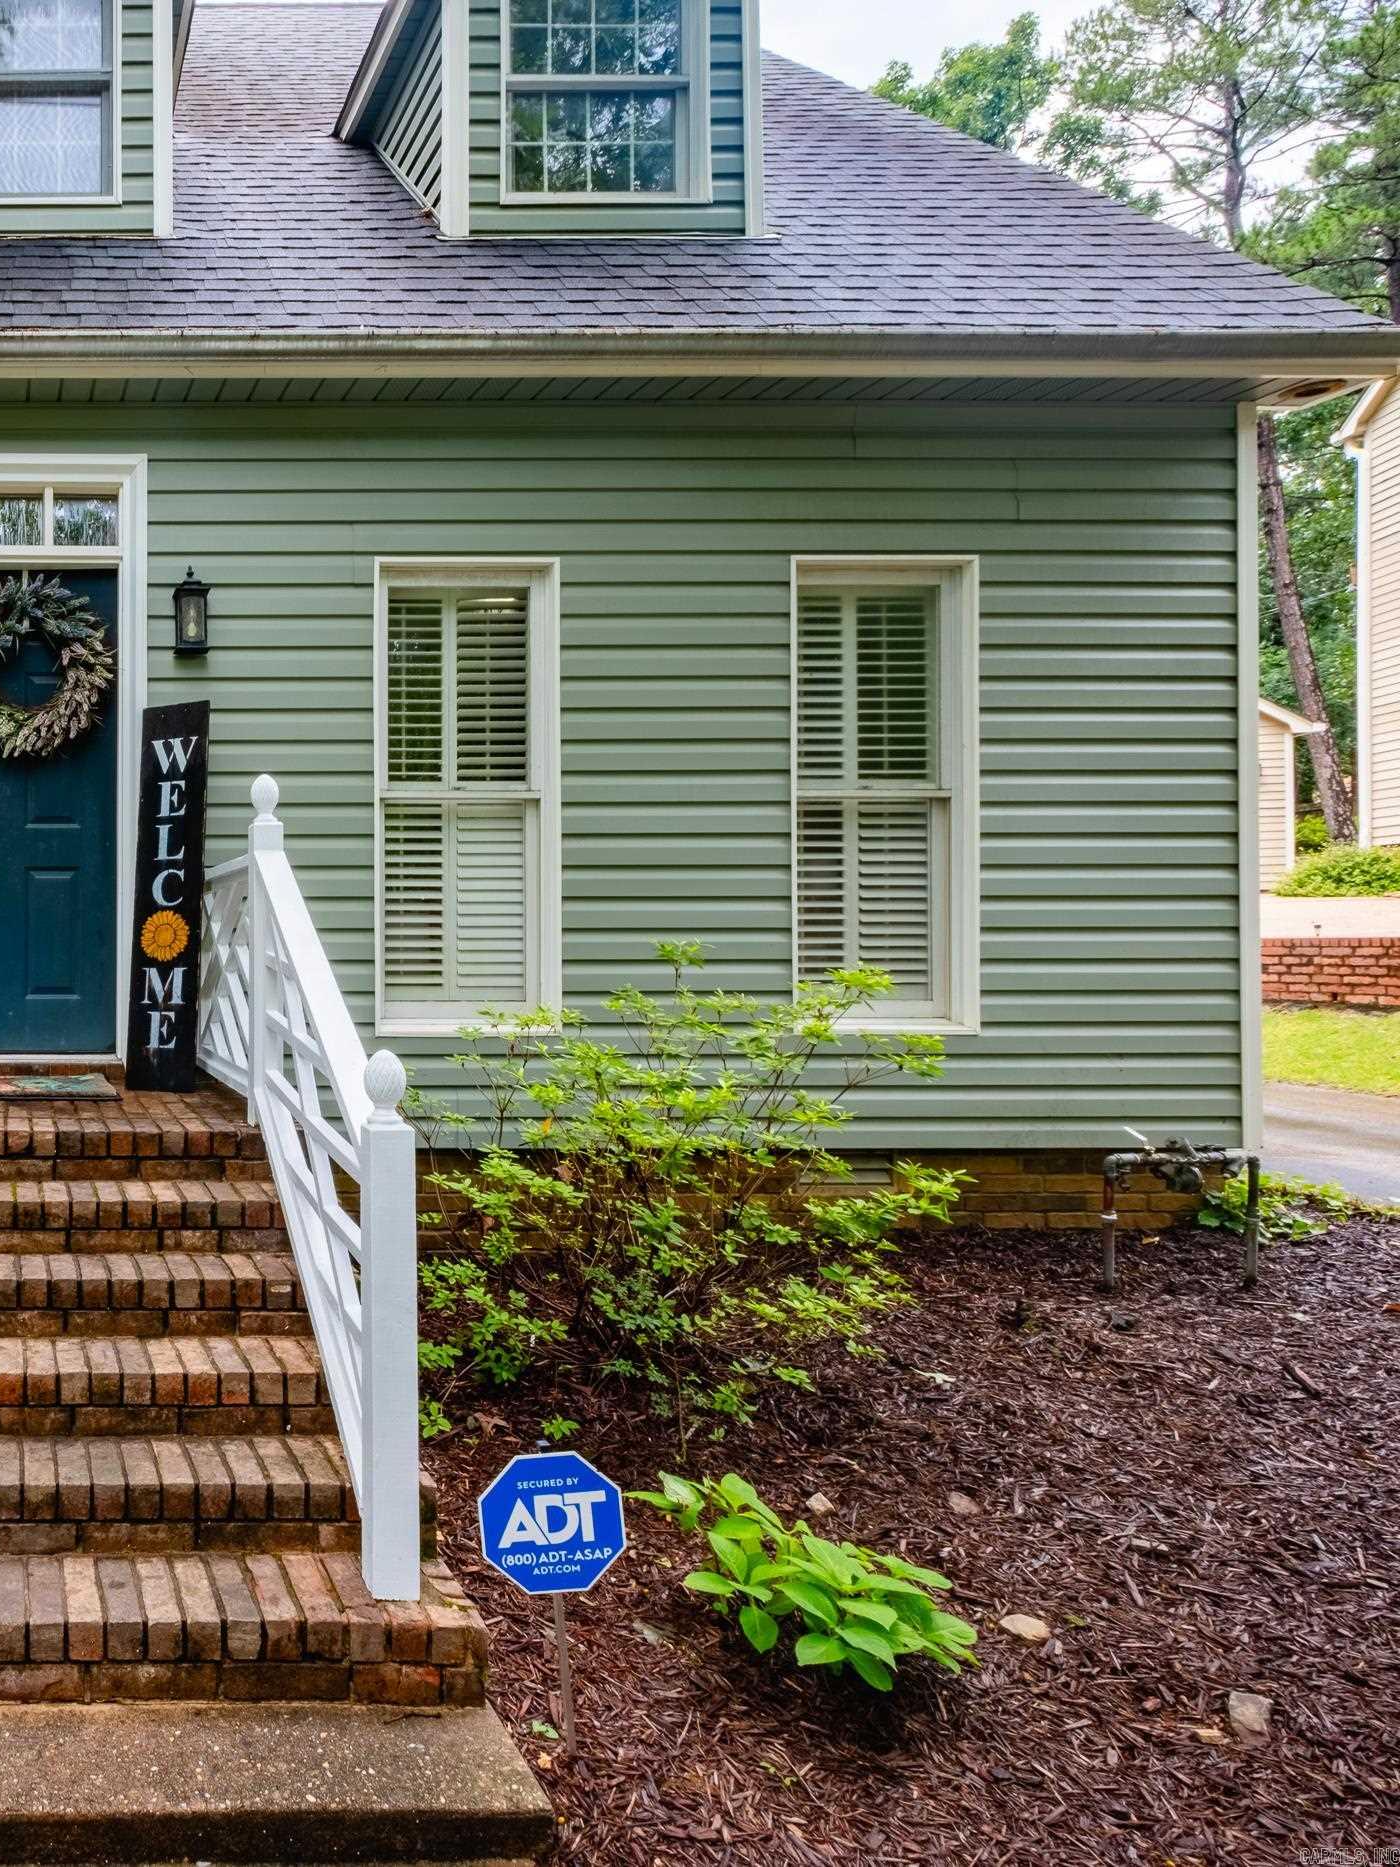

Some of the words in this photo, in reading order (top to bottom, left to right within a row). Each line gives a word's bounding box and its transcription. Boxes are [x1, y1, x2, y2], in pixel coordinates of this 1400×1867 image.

[516, 1478, 564, 1490] SECURED
[566, 1476, 579, 1486] BY
[498, 1490, 606, 1549] ADT
[501, 1551, 537, 1568] (800)
[538, 1547, 612, 1564] ADT-ASAP
[532, 1563, 581, 1576] ADT.COM
